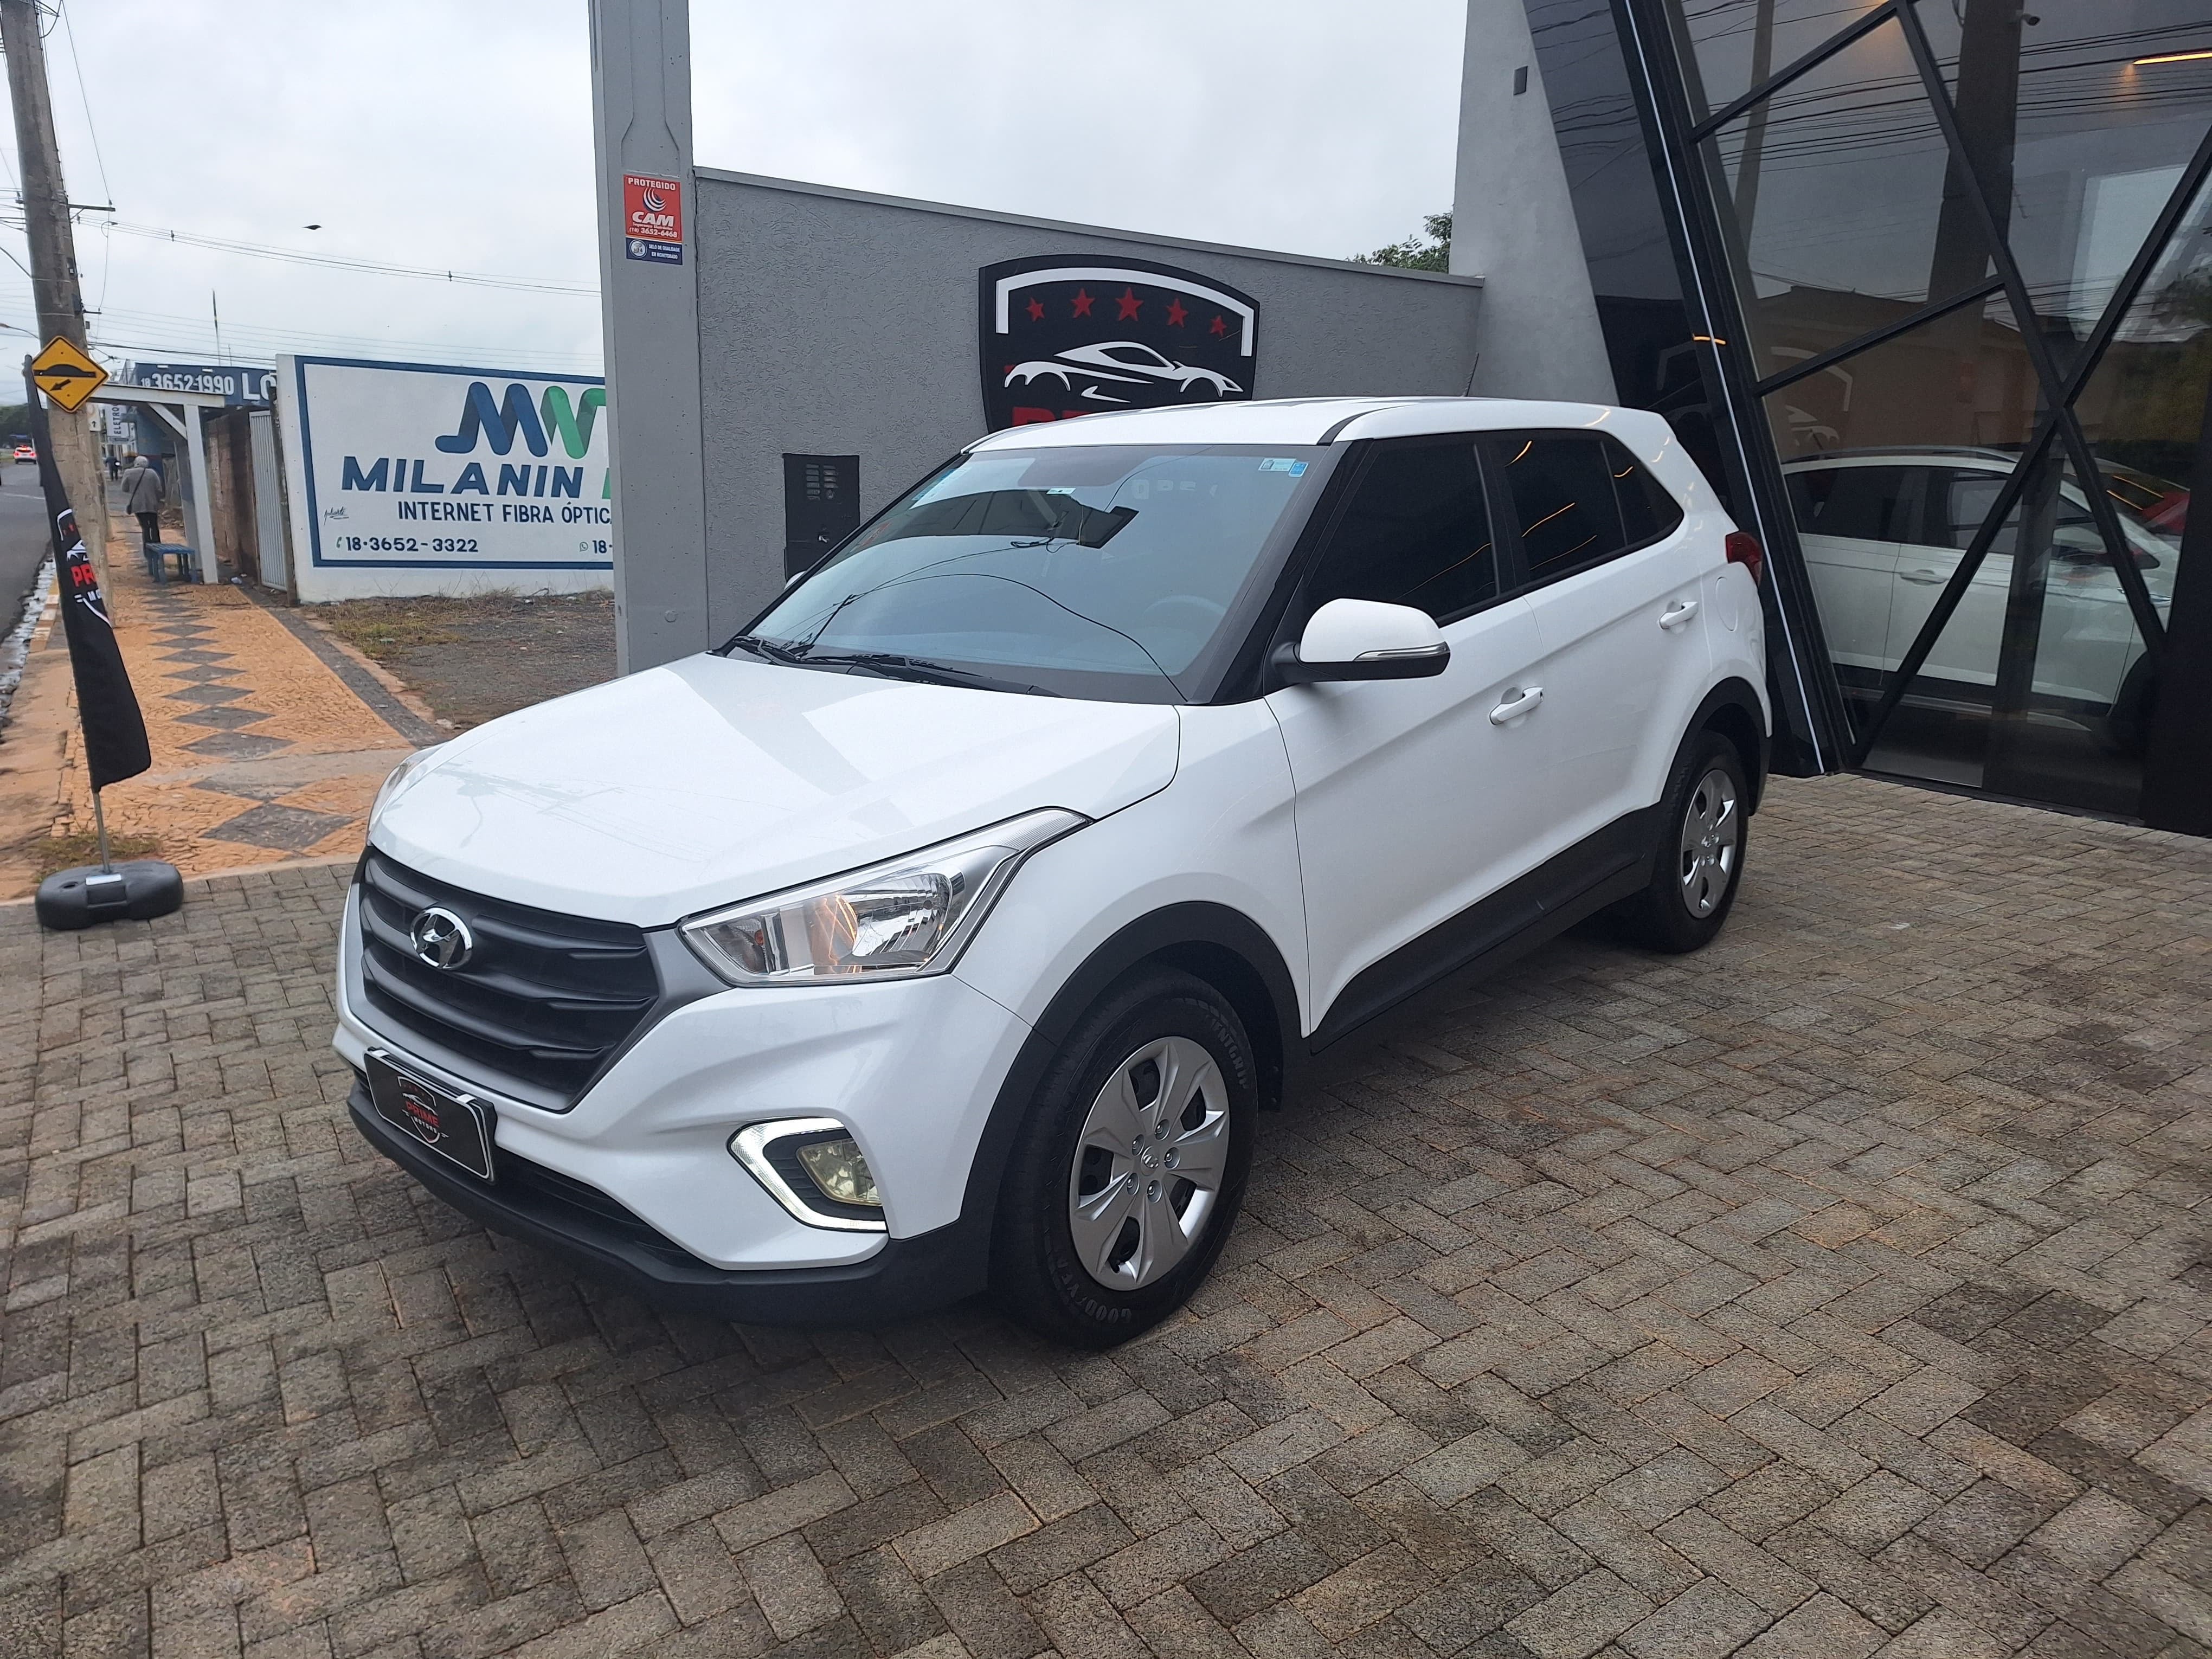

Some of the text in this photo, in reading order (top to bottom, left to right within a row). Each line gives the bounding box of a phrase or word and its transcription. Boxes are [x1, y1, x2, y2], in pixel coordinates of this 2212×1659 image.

[628, 177, 676, 190] PROTEGIDO
[632, 211, 674, 227] CAM
[640, 228, 678, 238] 3652-6468
[152, 373, 235, 395] 3652-1990
[112, 404, 121, 434] ELETRO
[342, 456, 583, 499] MILANIN
[398, 501, 612, 525] INTERNET FIBRA ÓPTIC
